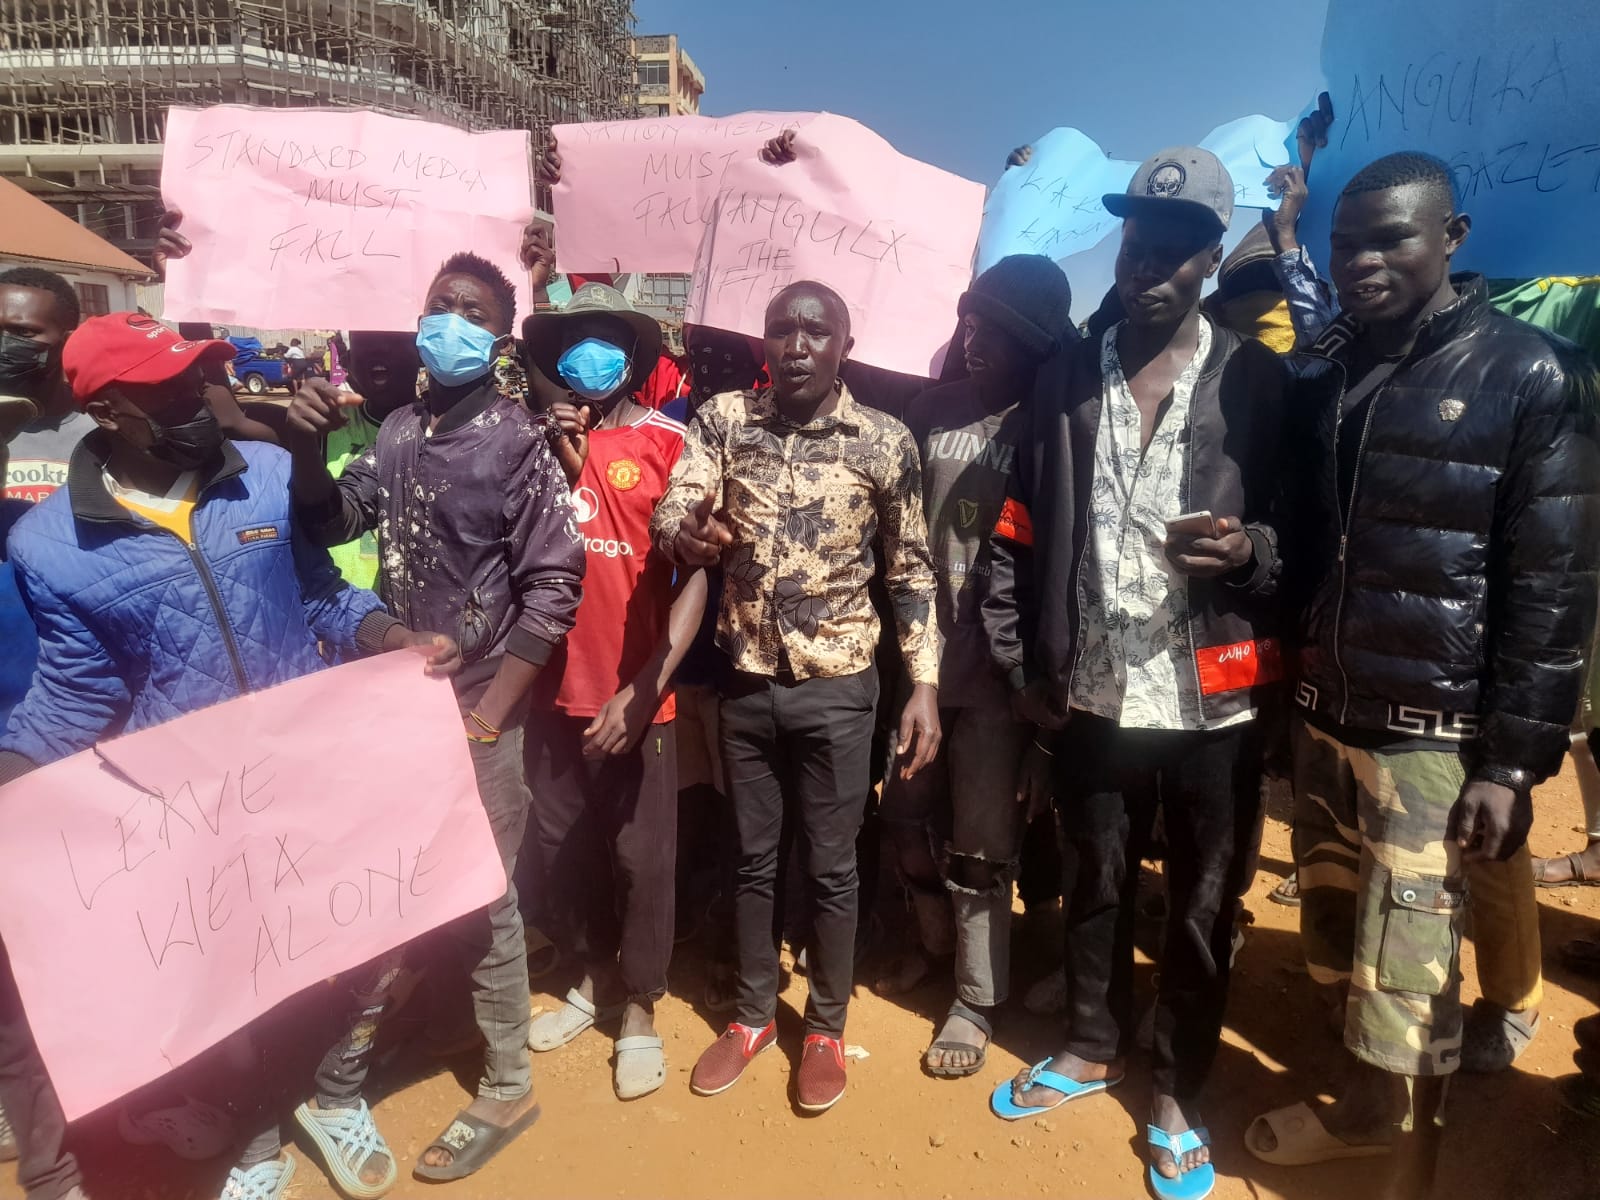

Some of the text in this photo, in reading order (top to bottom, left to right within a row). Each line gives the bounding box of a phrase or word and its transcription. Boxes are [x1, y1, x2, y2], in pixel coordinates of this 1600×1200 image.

[642, 150, 739, 185] MUST
[304, 179, 422, 217] MUST
[738, 238, 796, 272] THE
